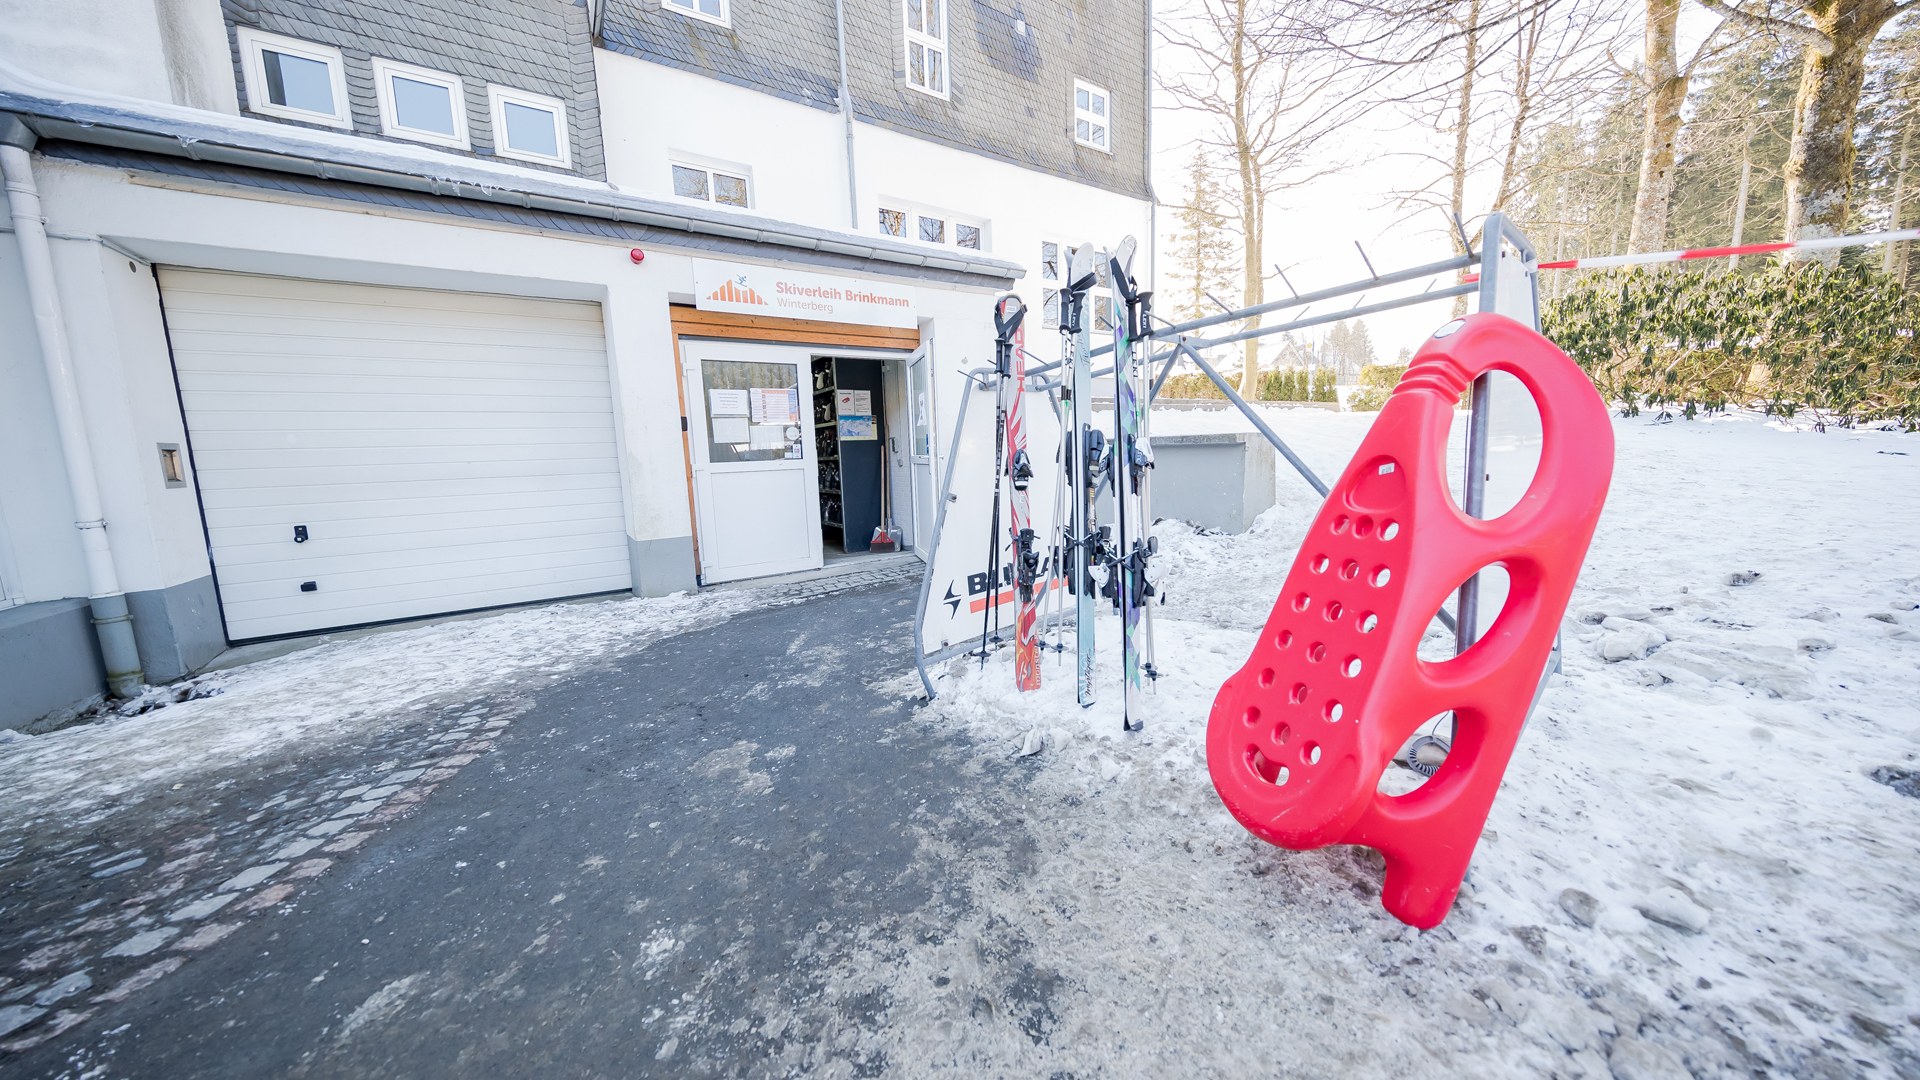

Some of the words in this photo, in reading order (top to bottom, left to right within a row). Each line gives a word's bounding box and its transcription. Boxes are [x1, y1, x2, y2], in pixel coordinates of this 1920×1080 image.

[775, 281, 842, 300] Skiverleih
[845, 289, 910, 308] Brinkmann
[777, 297, 834, 314] Winterberg
[1014, 327, 1026, 392] HEAD
